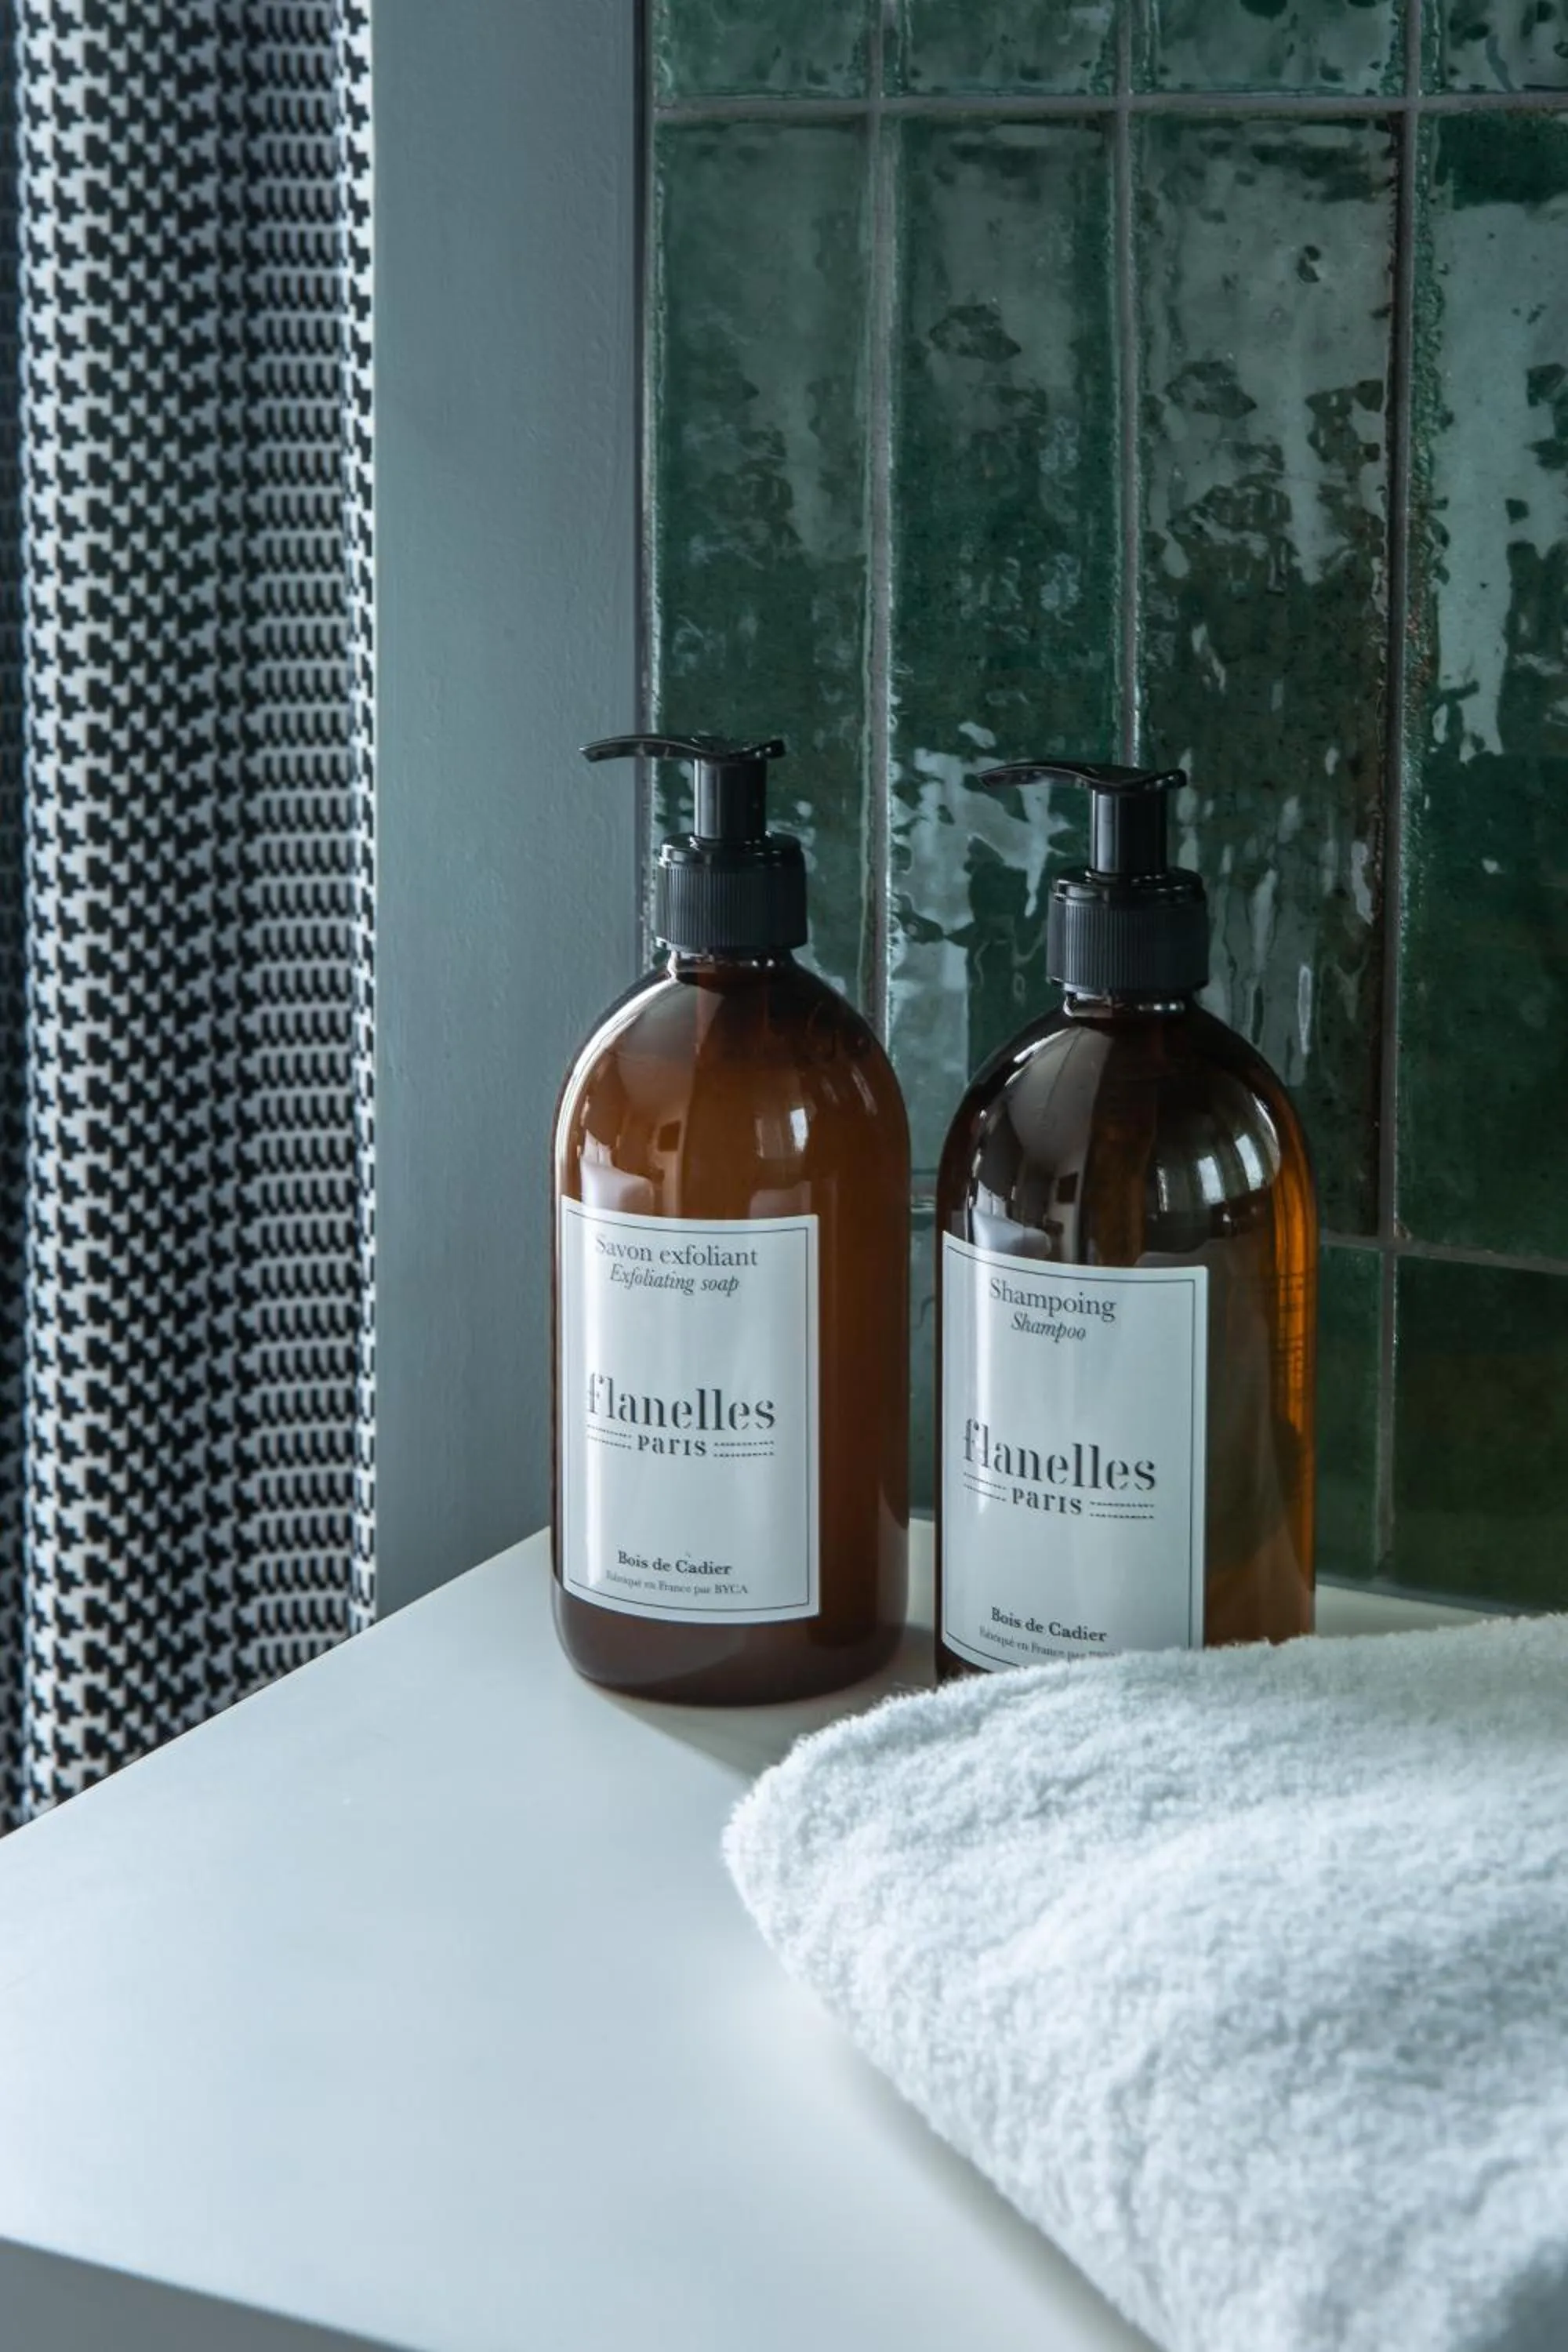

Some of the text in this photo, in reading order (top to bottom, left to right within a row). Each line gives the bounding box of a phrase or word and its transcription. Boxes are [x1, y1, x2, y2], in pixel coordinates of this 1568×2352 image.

[596, 1235, 758, 1266] Savon exfoliant
[610, 1263, 739, 1296] Exfoliating soap
[990, 1278, 1116, 1323] Shampoing
[1011, 1312, 1086, 1343] Shampoo
[589, 1372, 776, 1431] flanelles
[964, 1417, 1156, 1490] flanelles
[618, 1550, 648, 1569] Bois
[652, 1558, 671, 1571] de
[659, 1580, 691, 1593] France
[991, 1606, 1107, 1642] Bois de Cadier
